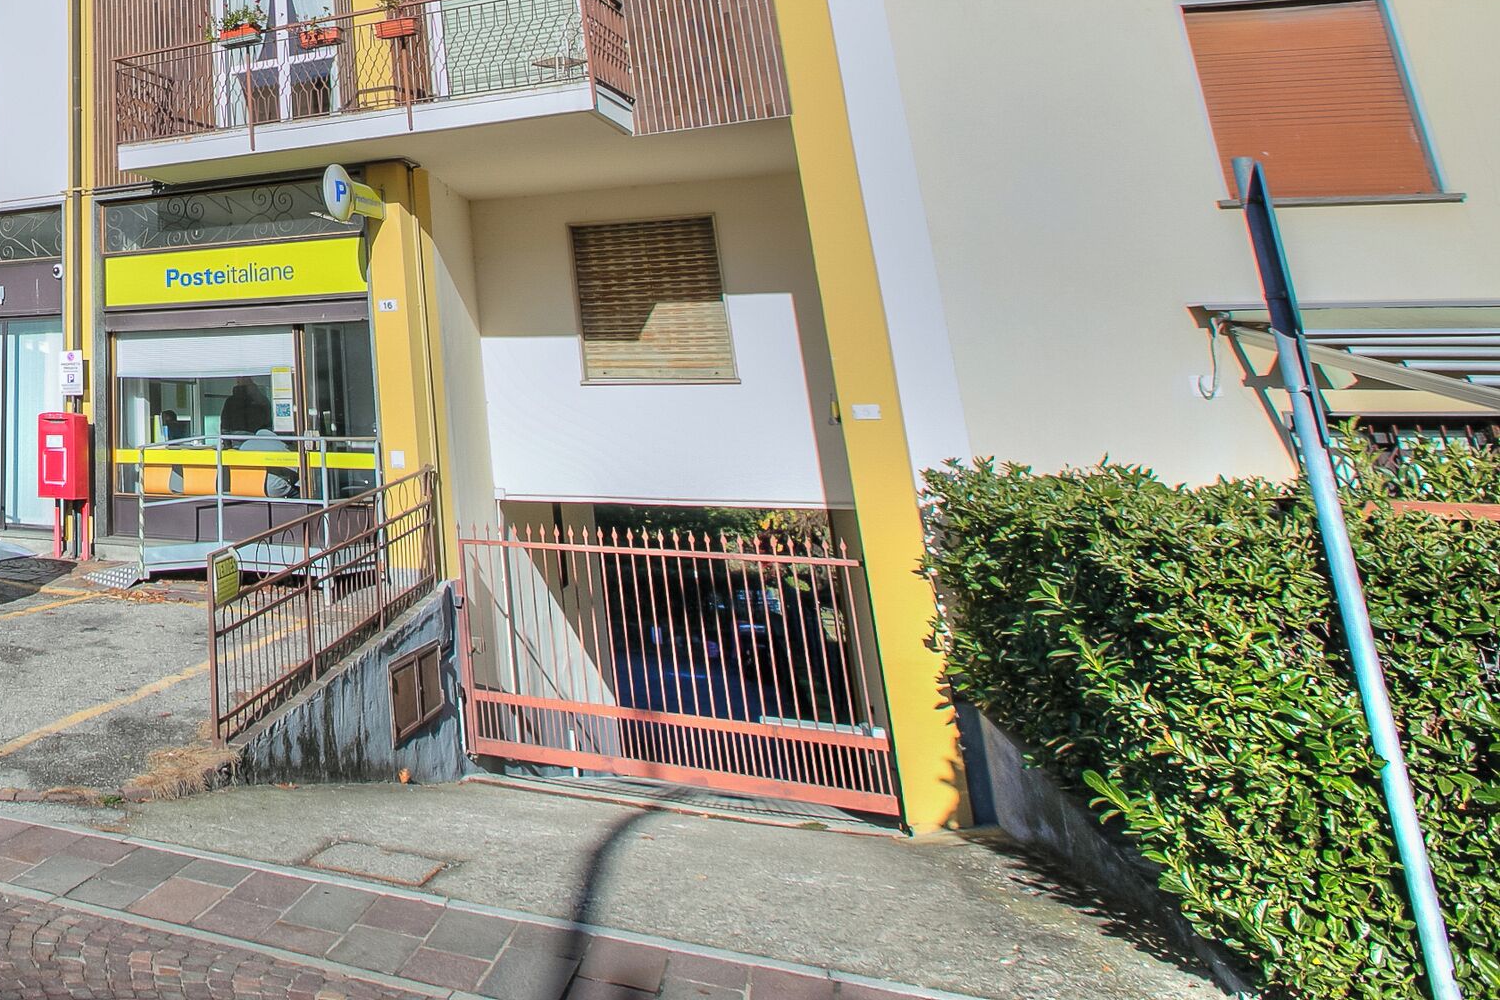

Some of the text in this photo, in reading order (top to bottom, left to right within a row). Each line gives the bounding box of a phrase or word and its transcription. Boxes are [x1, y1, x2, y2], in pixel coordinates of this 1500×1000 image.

[335, 180, 347, 202] P
[166, 262, 294, 288] Posteitaliane
[383, 301, 393, 310] 16
